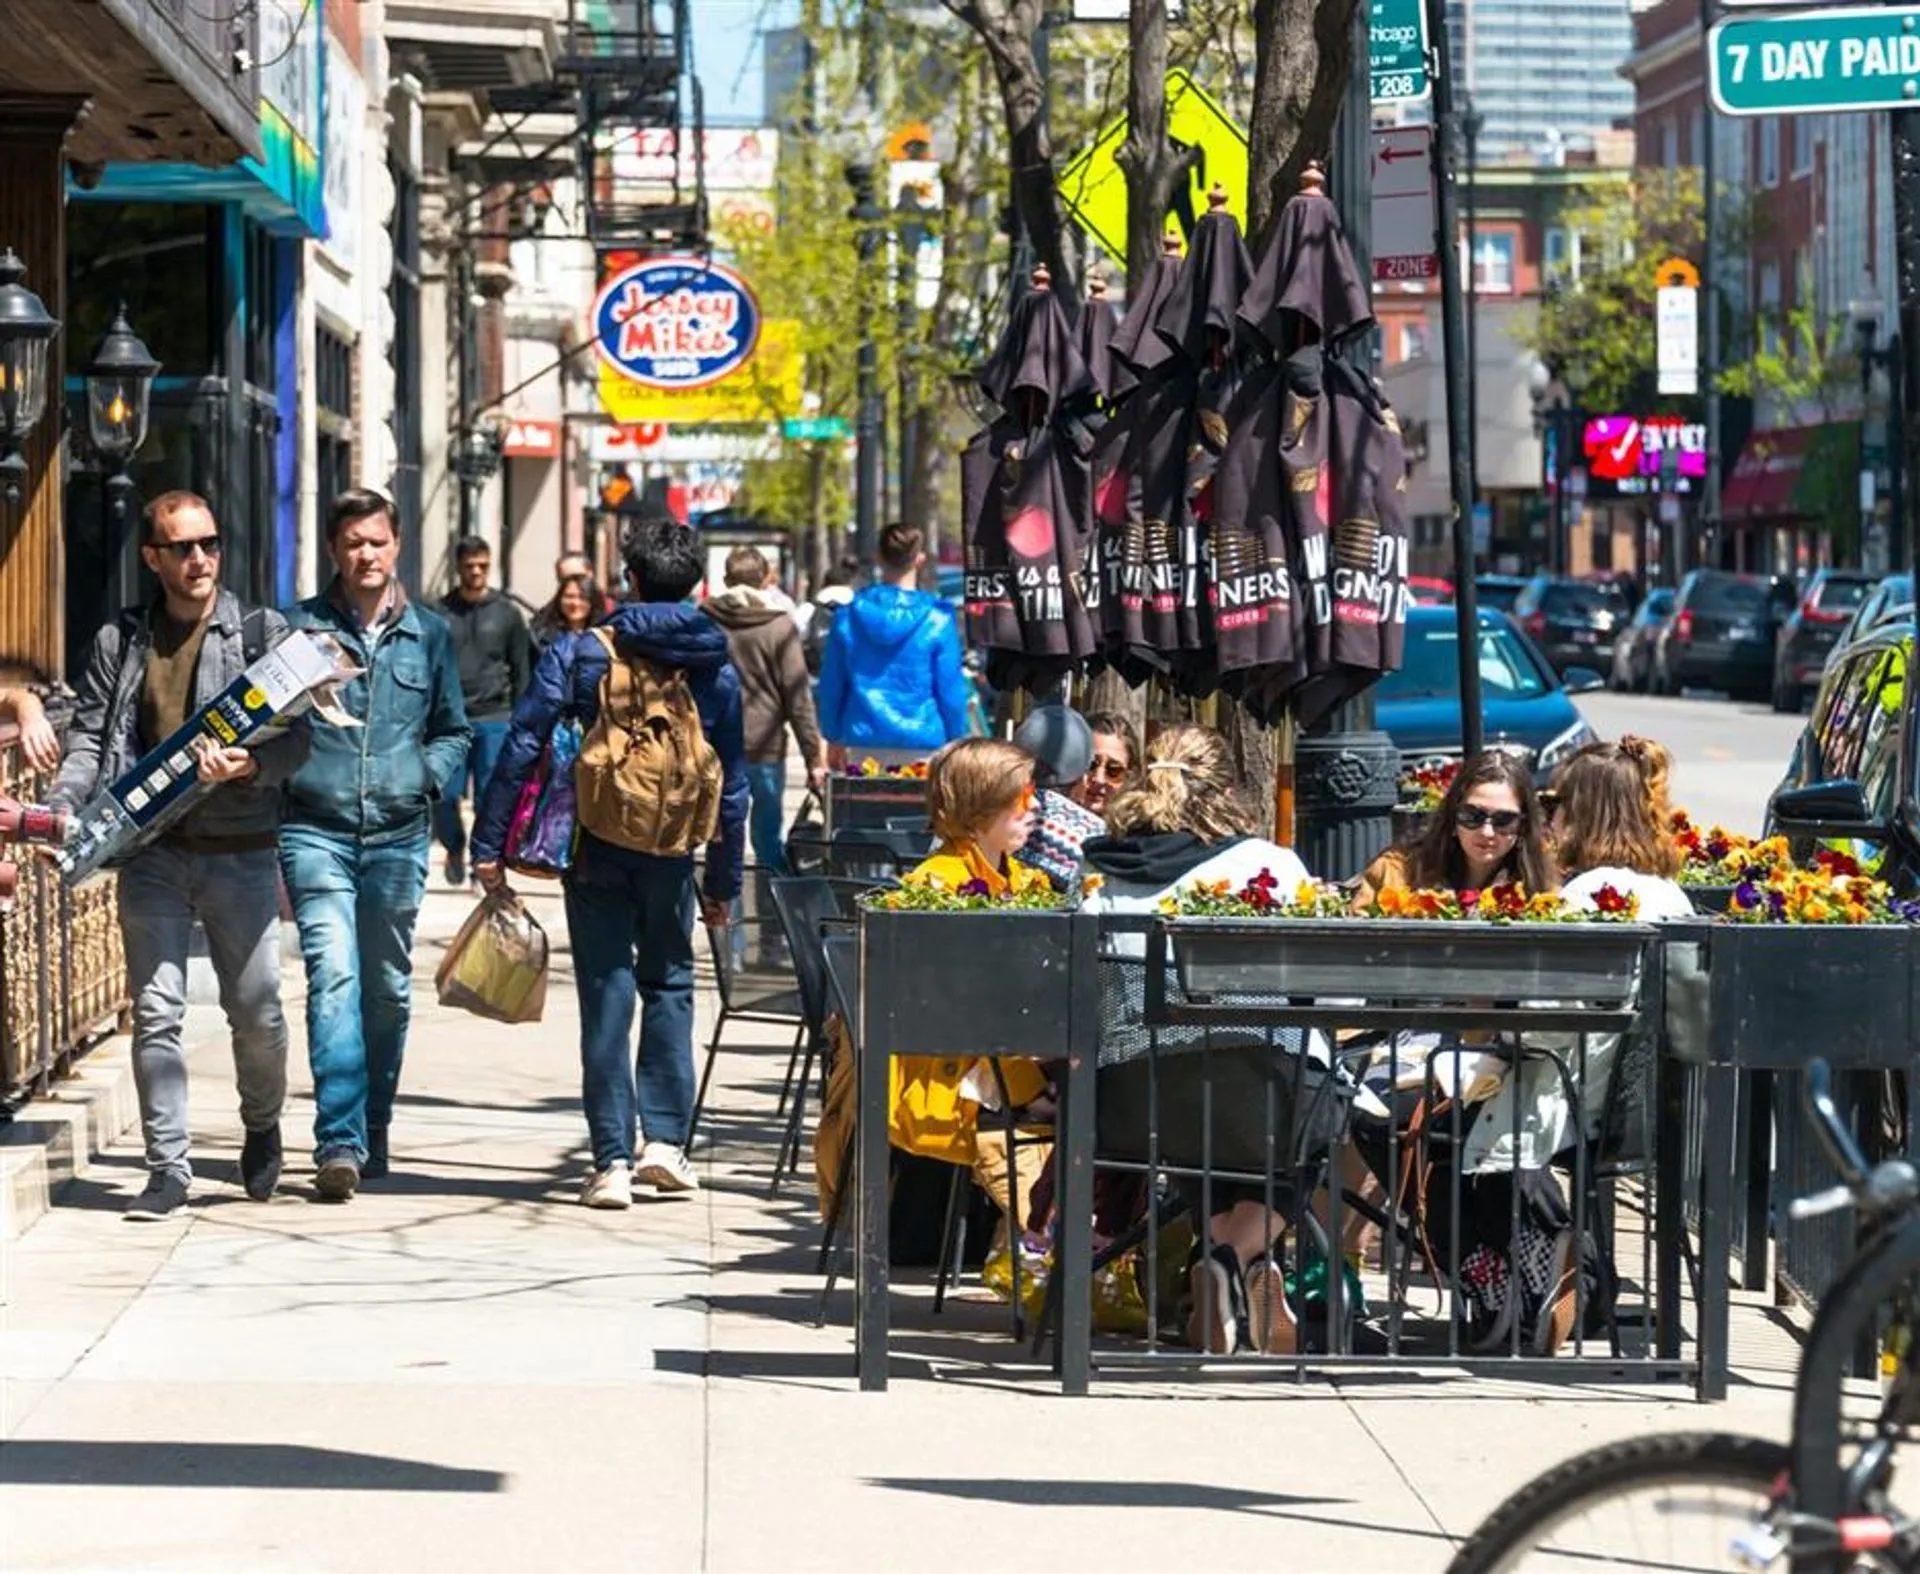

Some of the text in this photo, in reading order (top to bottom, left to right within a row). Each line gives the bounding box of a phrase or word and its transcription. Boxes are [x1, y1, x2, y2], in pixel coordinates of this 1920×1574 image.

[1370, 23, 1417, 44] hicago
[1726, 35, 1920, 84] 7 DAY PAID
[1380, 75, 1413, 96] 208
[1386, 257, 1430, 277] ZONE
[609, 279, 740, 328] Jersey
[1218, 567, 1290, 608] NERS
[1221, 607, 1260, 628] CIDER
